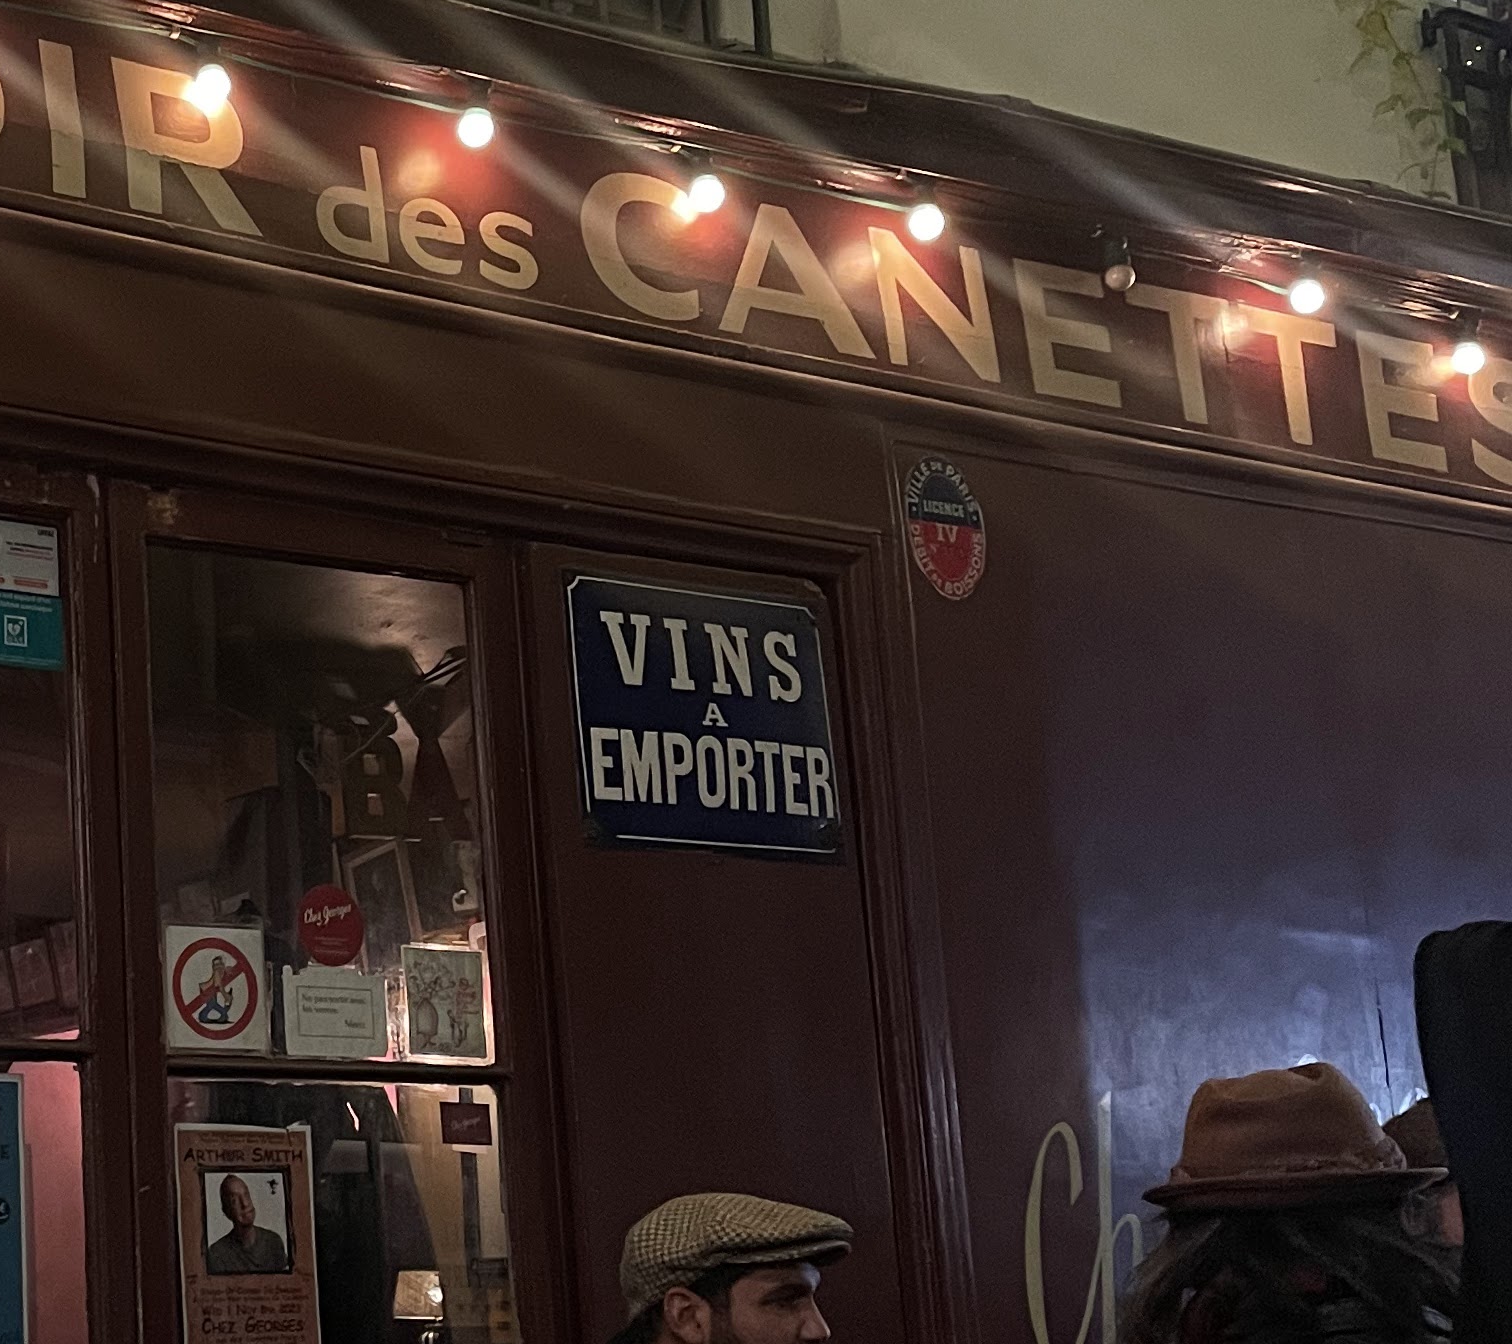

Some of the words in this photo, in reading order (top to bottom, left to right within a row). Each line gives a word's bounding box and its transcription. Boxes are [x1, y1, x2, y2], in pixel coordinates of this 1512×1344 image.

[316, 145, 538, 290] des
[579, 172, 1512, 488] CANETTES
[907, 462, 931, 503] VILLE
[945, 464, 978, 513] PARIS
[923, 499, 964, 518] LICENCE
[936, 523, 959, 543] IV
[944, 533, 983, 595] BOISSONS
[600, 610, 802, 703] VINS
[702, 702, 729, 727] A
[590, 727, 834, 819] EMPORTER
[183, 1147, 246, 1162] ARTHUR
[251, 1147, 303, 1163] SMITH
[201, 1317, 238, 1335] CHEZ
[244, 1316, 305, 1334] GEORGES
